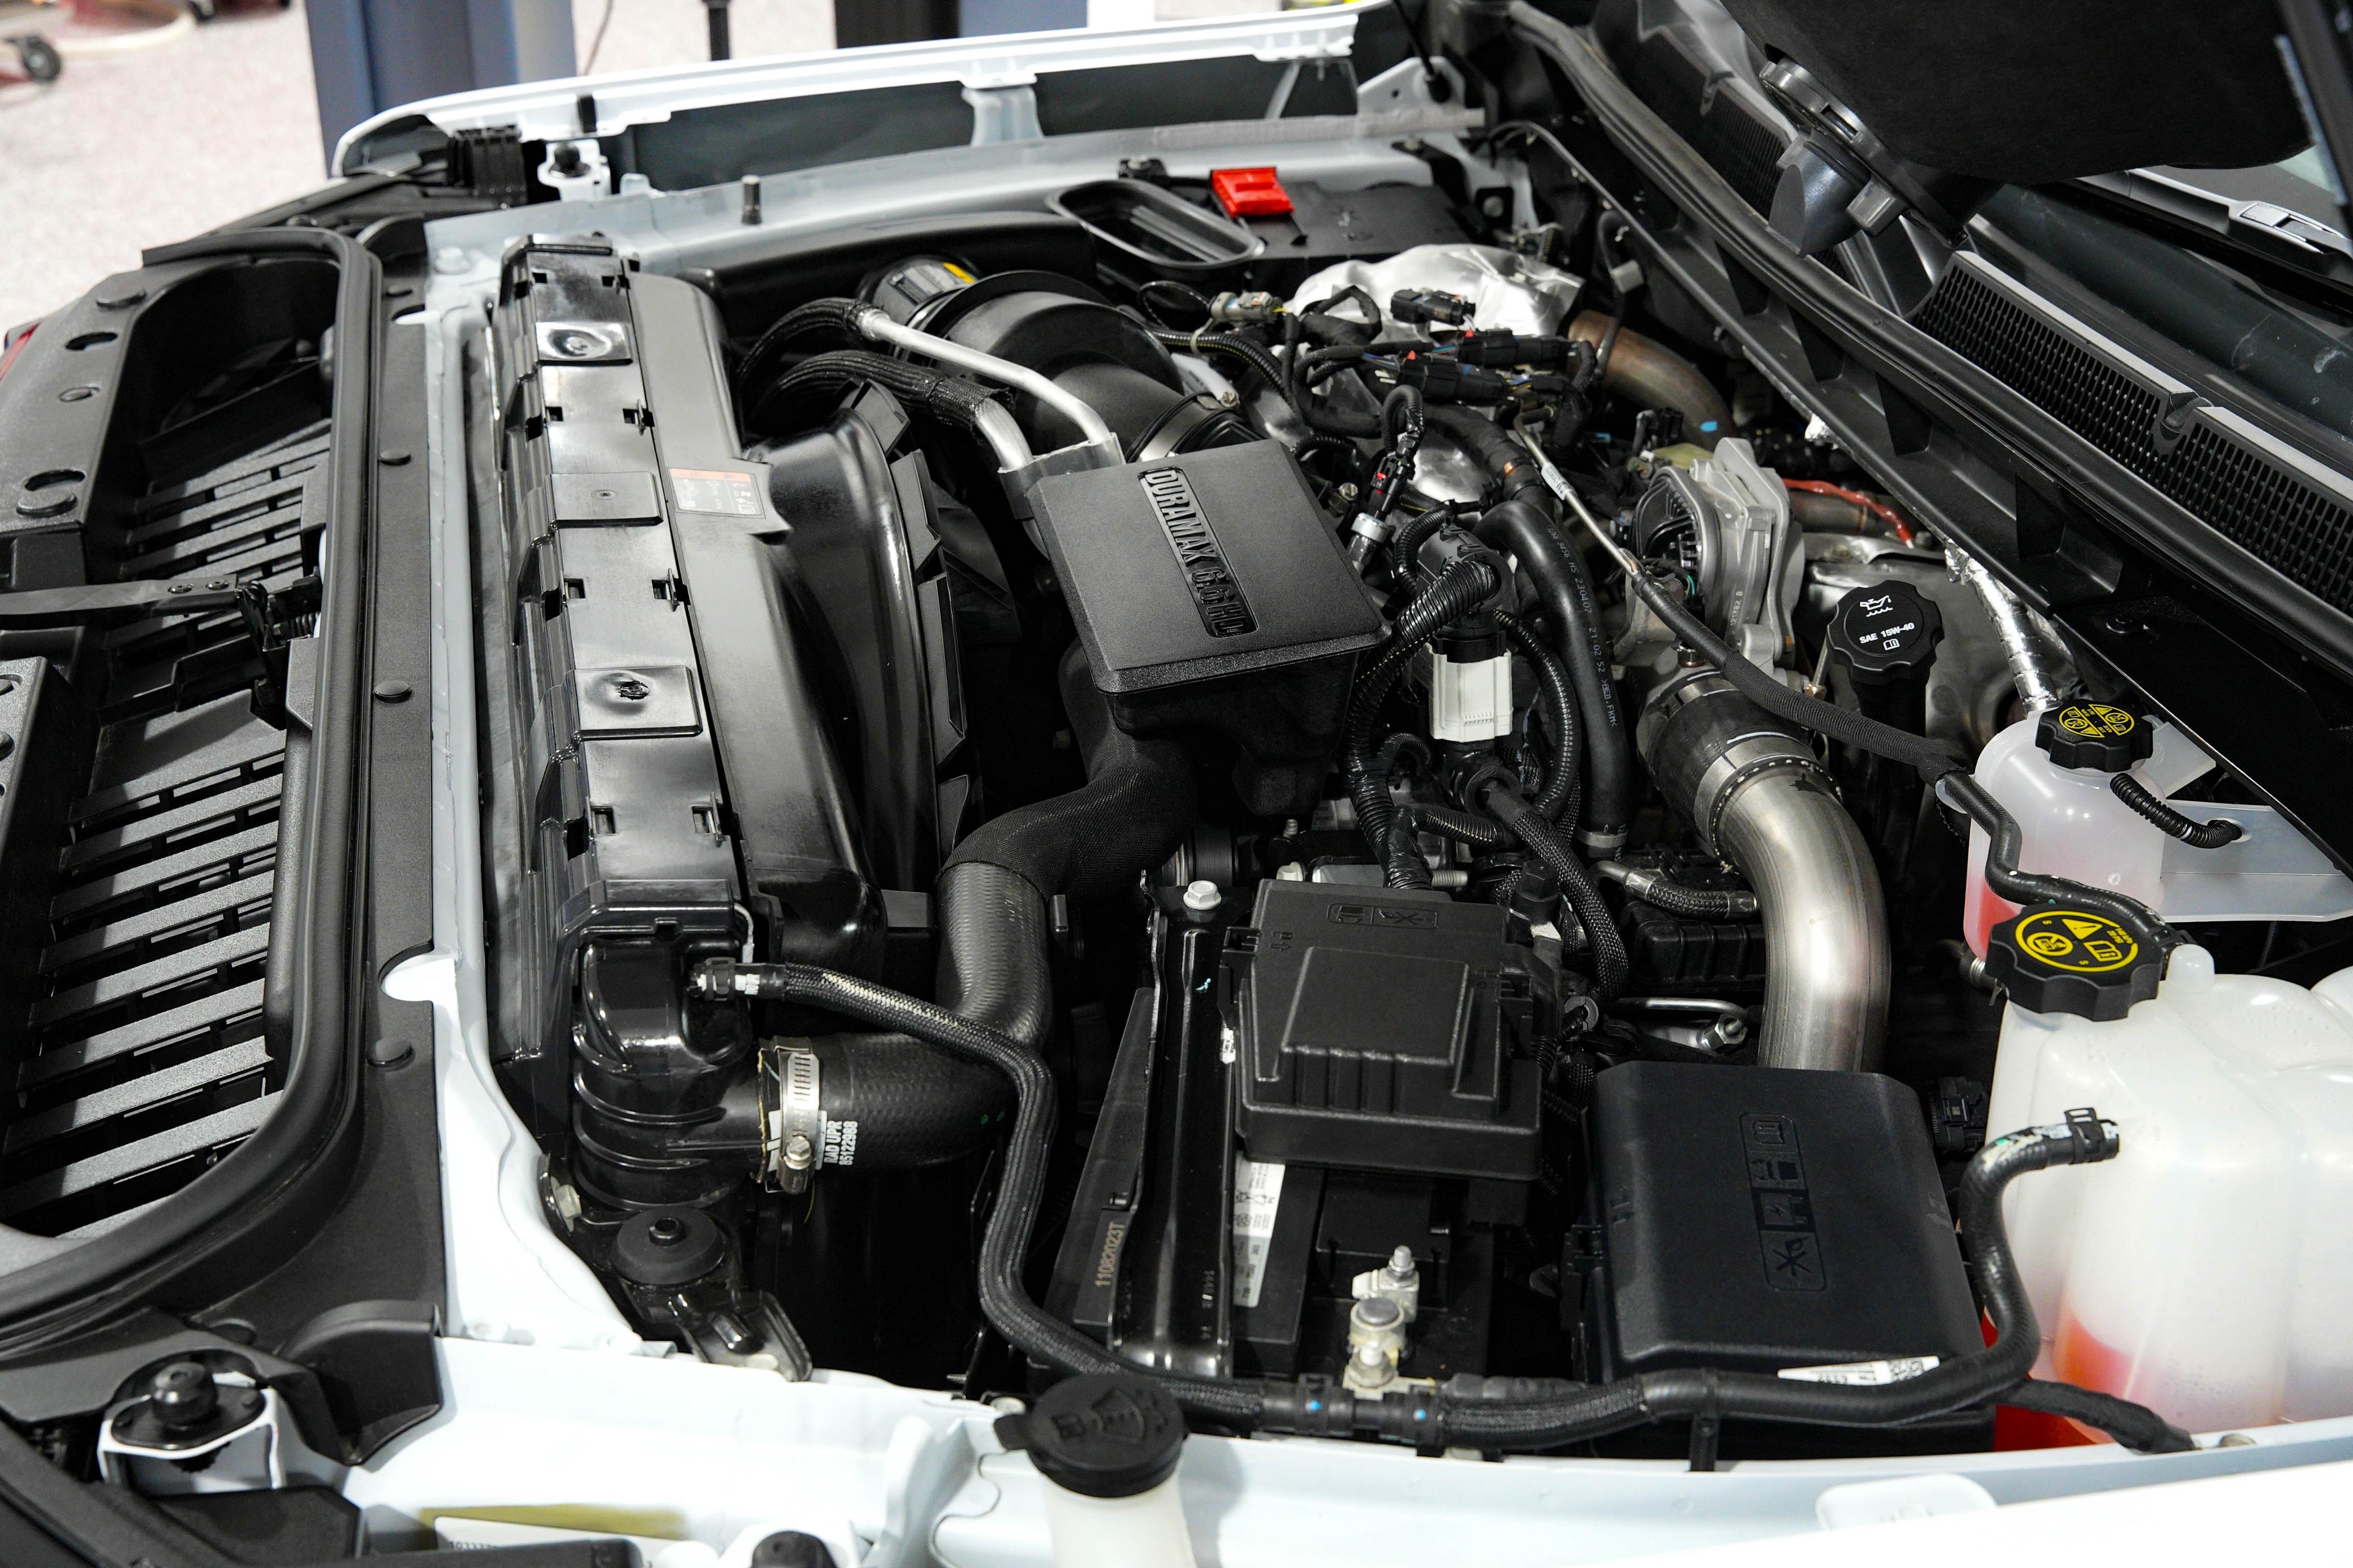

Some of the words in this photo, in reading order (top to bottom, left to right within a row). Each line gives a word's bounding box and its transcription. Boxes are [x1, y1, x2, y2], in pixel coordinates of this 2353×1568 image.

[1145, 469, 1219, 566] DURAMAX
[1191, 568, 1234, 603] 6.6
[1574, 577, 1591, 613] 230407
[1207, 602, 1251, 633] HD
[1859, 633, 1878, 643] SAE
[1881, 623, 1915, 637] 15W-40
[826, 1121, 842, 1142] UPR
[839, 1121, 858, 1165] 85122988
[824, 1143, 841, 1163] RAD
